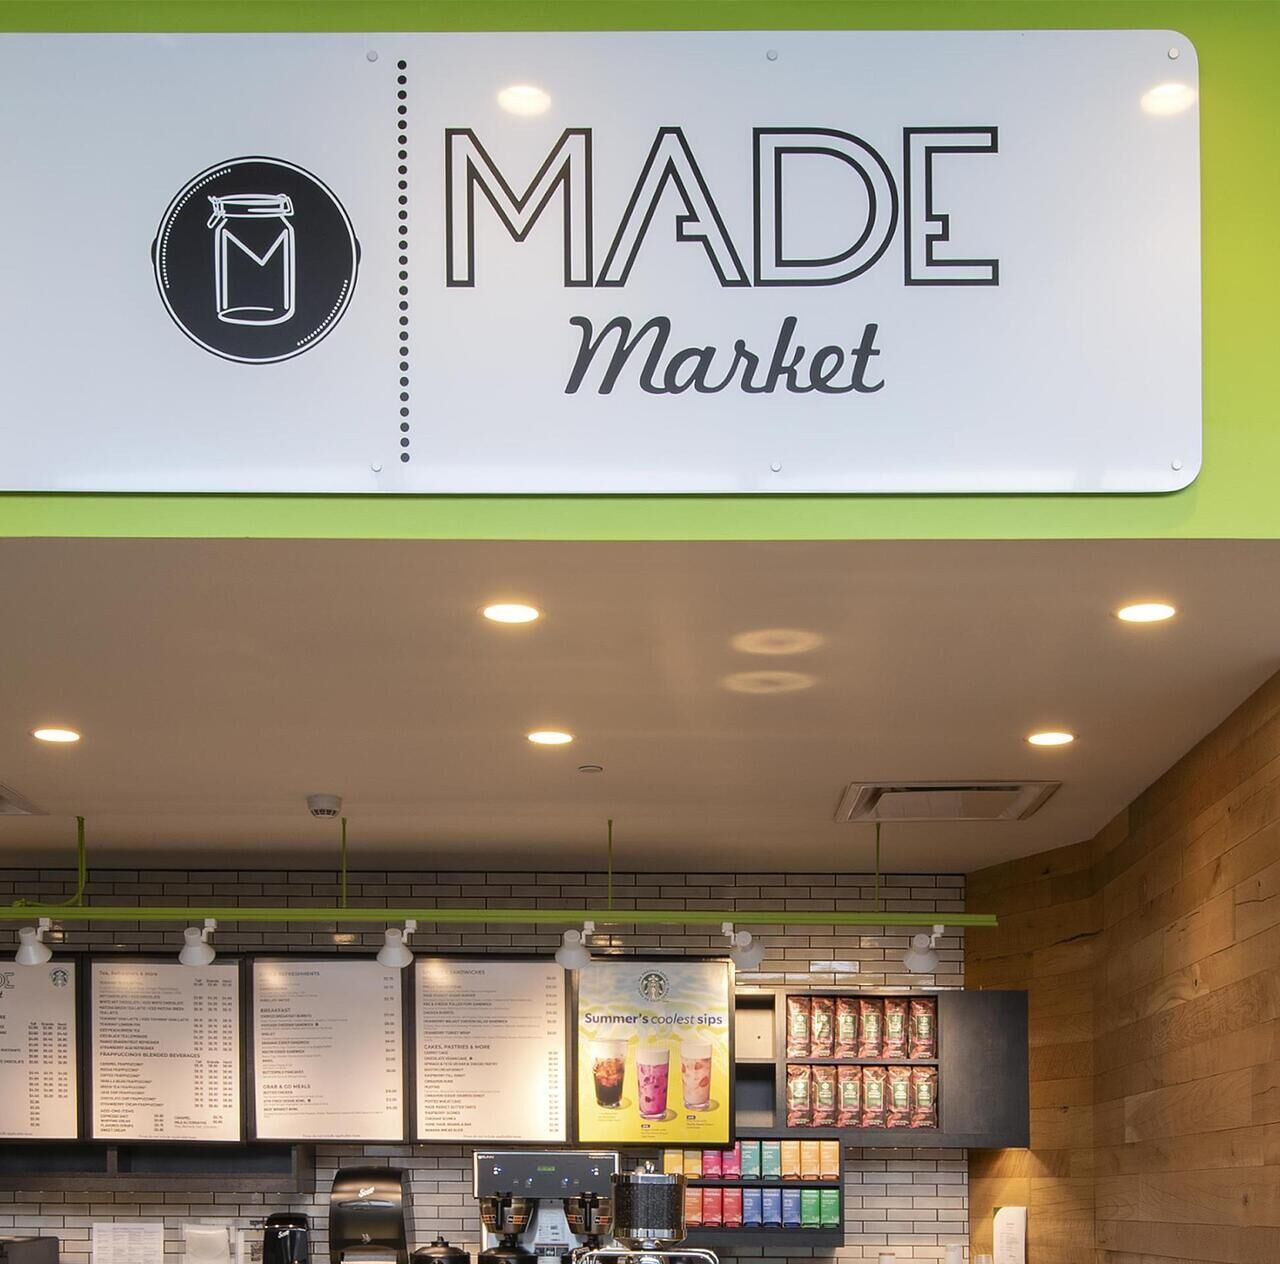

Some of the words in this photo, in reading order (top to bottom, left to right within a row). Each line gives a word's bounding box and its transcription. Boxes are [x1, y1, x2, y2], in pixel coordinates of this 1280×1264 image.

[445, 126, 1000, 288] MADE
[564, 316, 885, 396] Market
[585, 1012, 649, 1024] Summer's
[651, 1013, 694, 1025] coolest
[697, 1013, 723, 1027] sips
